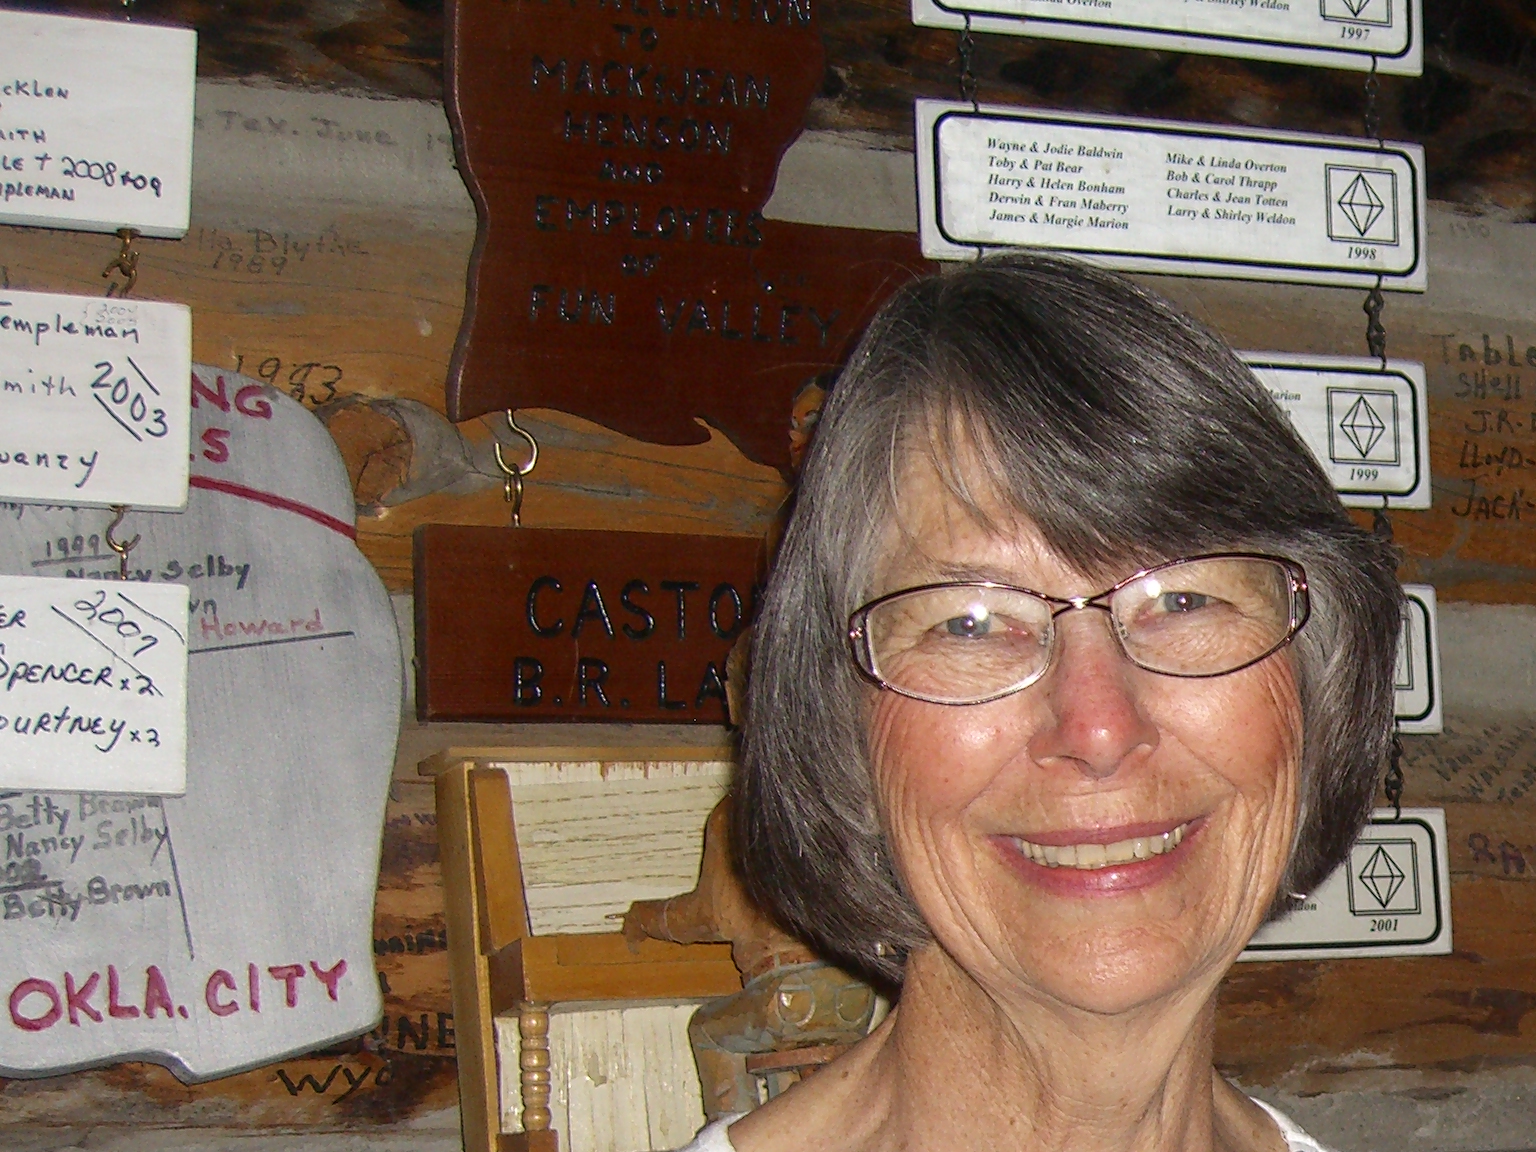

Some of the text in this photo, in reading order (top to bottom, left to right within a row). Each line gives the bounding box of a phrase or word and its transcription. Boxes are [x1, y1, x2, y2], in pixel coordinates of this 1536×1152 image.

[613, 24, 658, 50] TO
[1340, 26, 1371, 41] 1997
[563, 111, 733, 157] HENSON
[988, 138, 1123, 159] Wayne & Jodie Baldwin
[599, 159, 664, 185] AND
[988, 155, 1084, 174] Toby & Pat Bear
[1166, 152, 1287, 173] Mike & Linda Overton
[988, 173, 1125, 194] Harry & Helen Bonham
[1166, 170, 1278, 192] Bob & Carol Thrapp
[989, 191, 1129, 215] Derwin & Fran Maberry
[1167, 187, 1288, 207] Charles & Jean Totten
[535, 195, 763, 249] EMPLOYEES
[989, 209, 1129, 230] James & Margie Marion
[1167, 205, 1296, 225] Larry & Shirley Weldon
[1346, 246, 1377, 261] 1998
[621, 254, 660, 277] OF
[529, 284, 840, 347] FUN VALLEY
[4, 369, 76, 397] mith
[91, 361, 168, 438] 2003
[1350, 468, 1378, 481] 1999
[525, 576, 760, 640] CASTO
[6, 814, 170, 866] Nancy Selby
[1370, 919, 1398, 932] 2001
[9, 959, 348, 1032] OKLA. CITY
